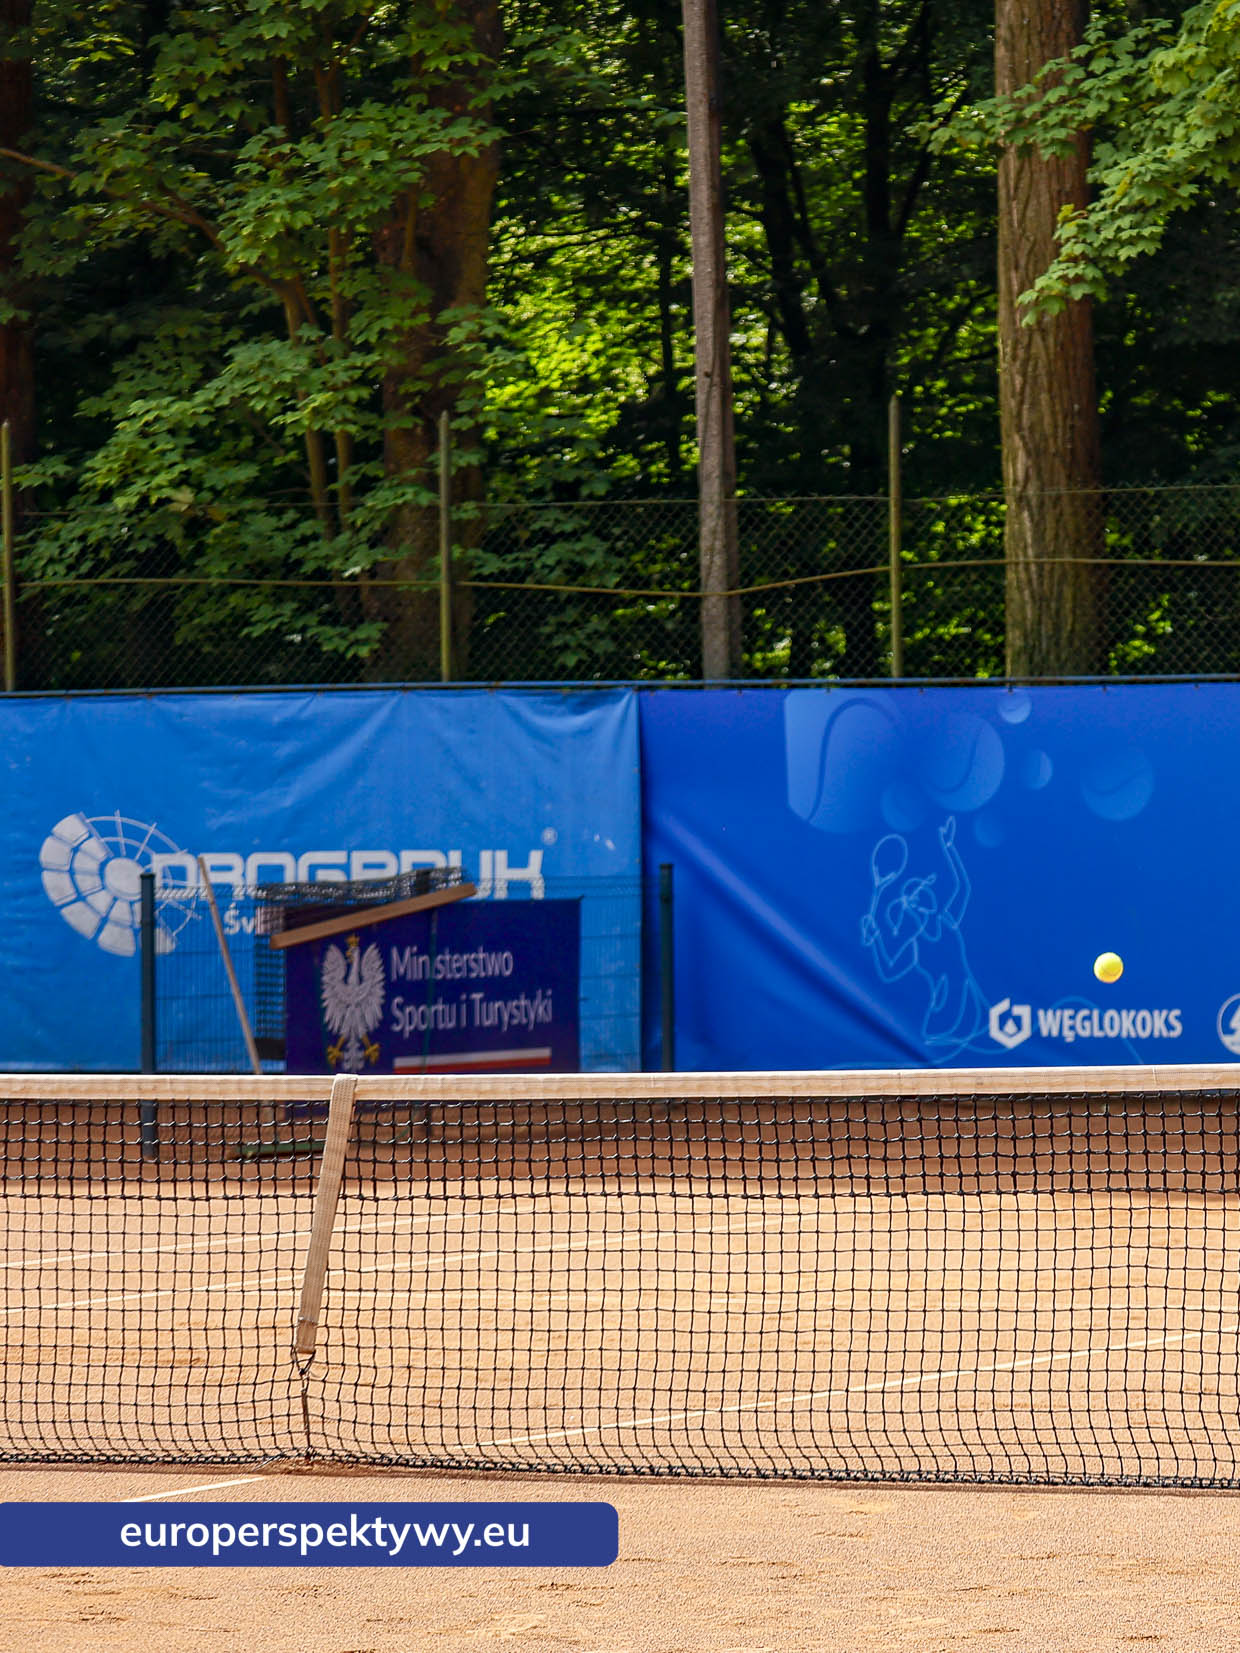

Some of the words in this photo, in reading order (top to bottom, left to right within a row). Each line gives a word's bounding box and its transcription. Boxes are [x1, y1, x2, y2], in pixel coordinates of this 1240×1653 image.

[391, 945, 514, 983] Minsterstwo
[390, 995, 457, 1040] Sportu
[460, 992, 468, 1029] i
[470, 988, 553, 1033] Turystyki
[1037, 1008, 1183, 1043] WĘGLOKOKS
